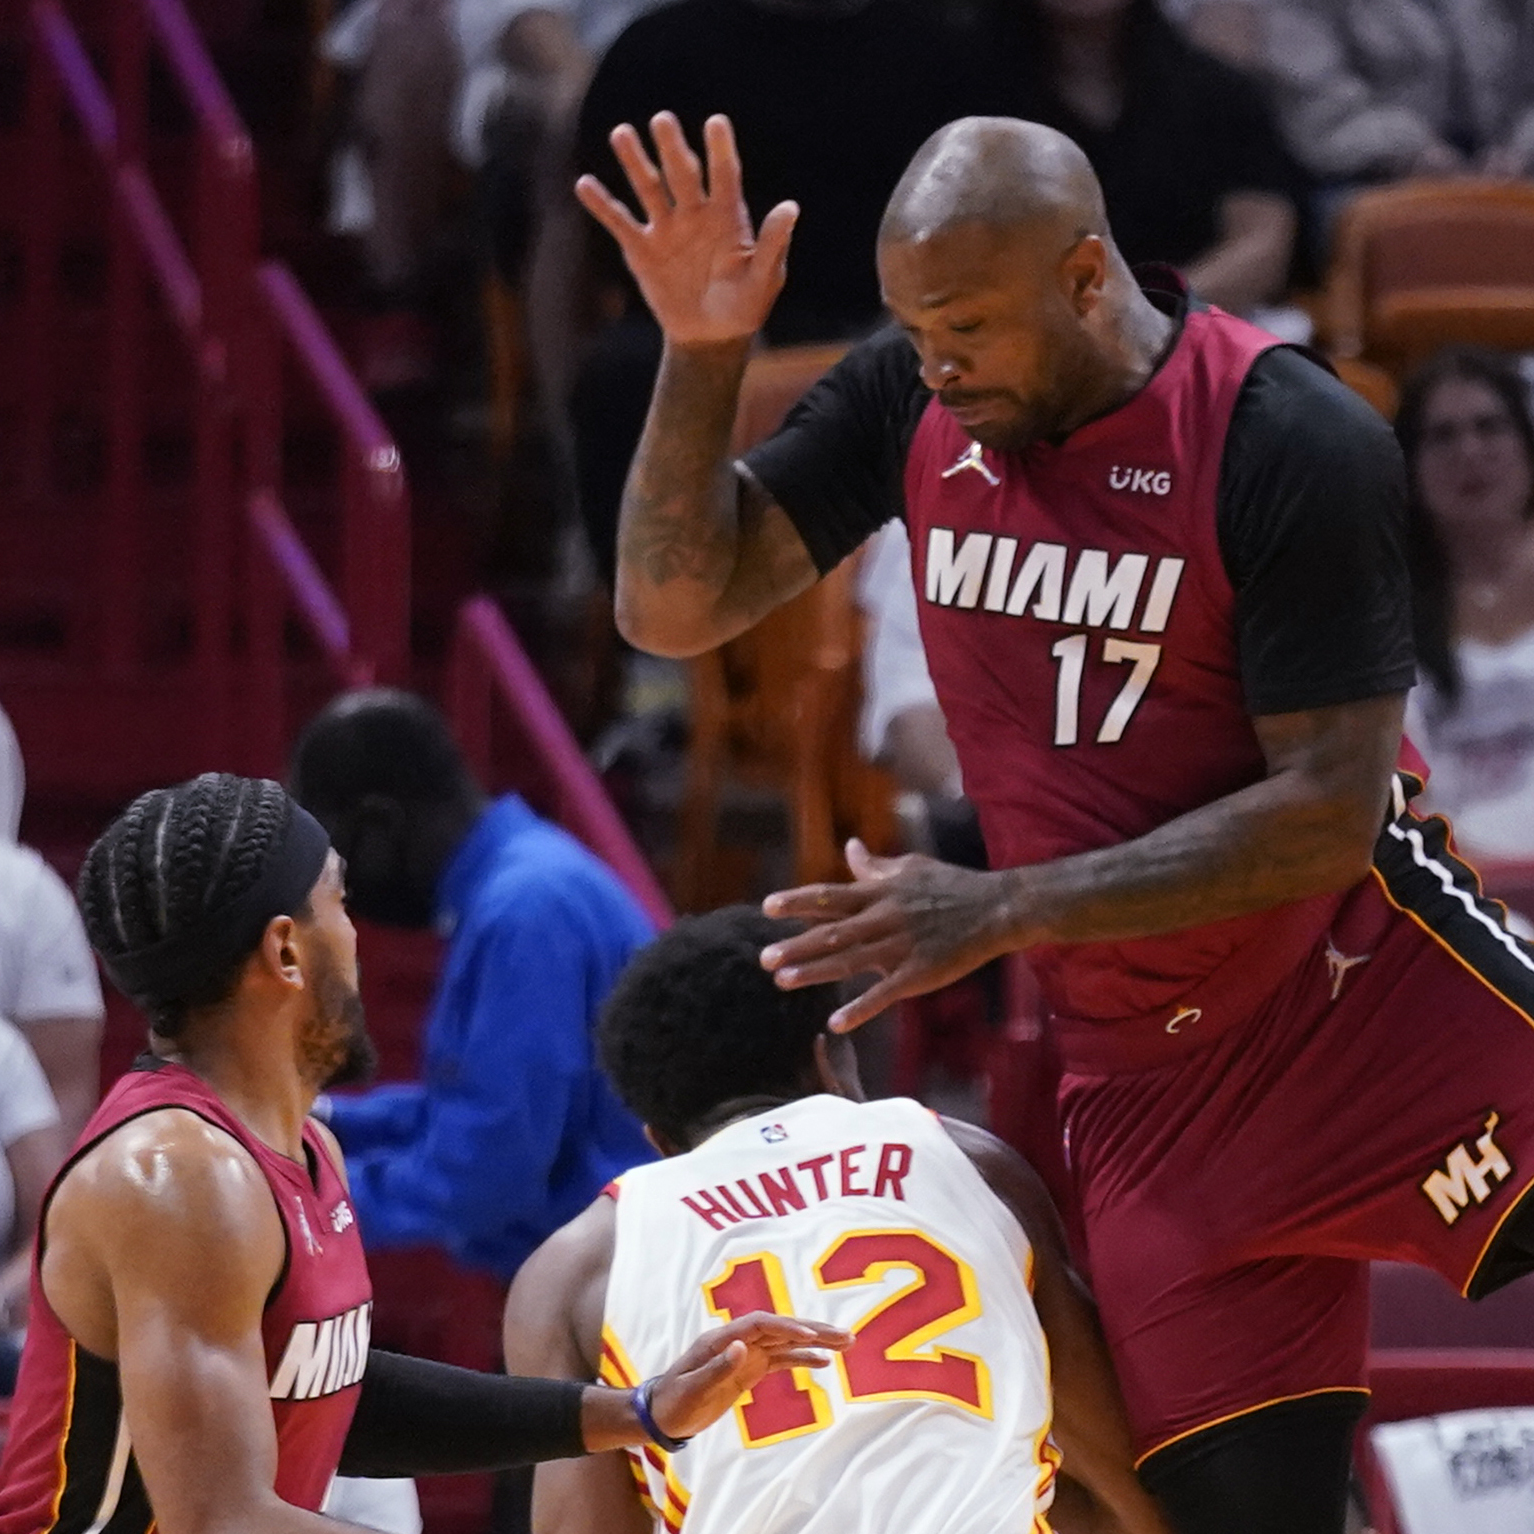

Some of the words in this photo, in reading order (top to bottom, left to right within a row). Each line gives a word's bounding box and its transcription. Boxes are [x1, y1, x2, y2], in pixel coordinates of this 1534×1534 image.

[925, 526, 1186, 634] MIAMI
[1050, 632, 1163, 747] 17
[679, 1142, 914, 1232] HUNTER
[269, 1299, 373, 1400] MIA
[702, 1227, 995, 1449] 12
